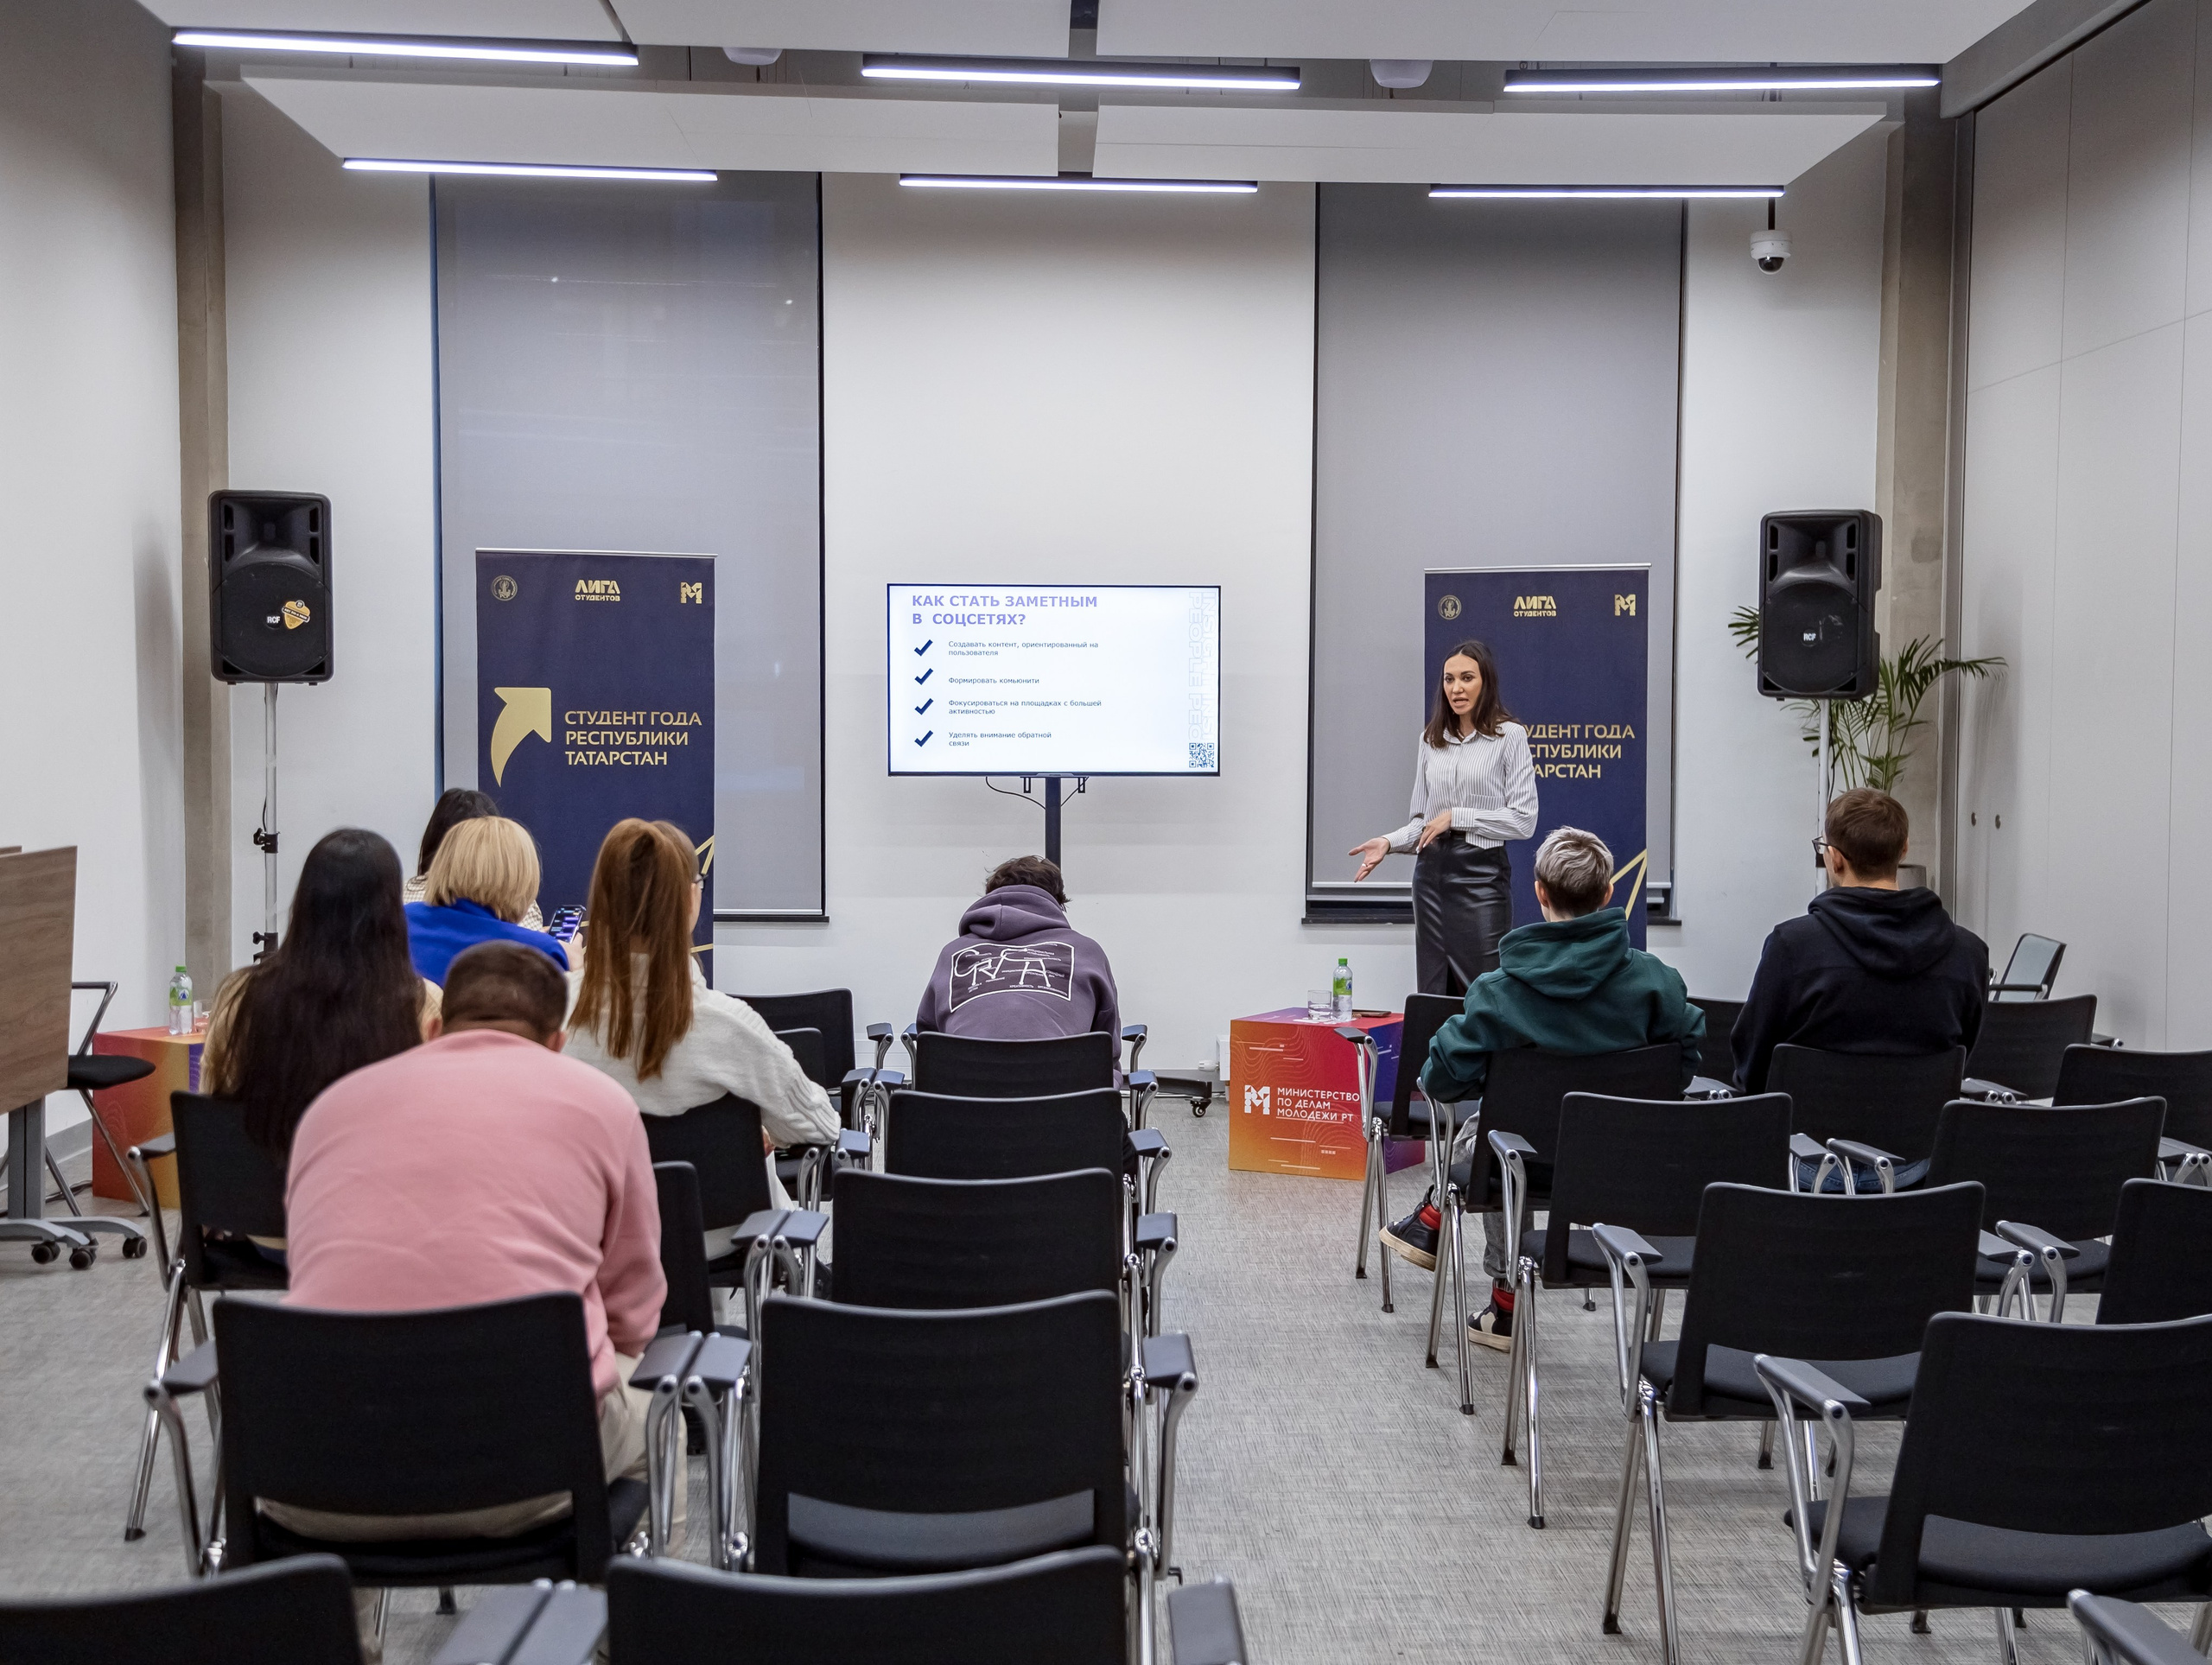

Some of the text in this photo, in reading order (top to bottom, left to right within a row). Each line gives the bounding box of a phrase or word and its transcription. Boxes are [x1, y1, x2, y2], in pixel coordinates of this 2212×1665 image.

[575, 579, 621, 594] ЛИГА
[575, 594, 621, 602] СТУДЕНТОВ
[912, 594, 1097, 607] КАК СТАТЬ ЗАМЕТНЫМ
[1513, 595, 1557, 610] ЛИГА
[266, 615, 281, 624] RCF
[912, 613, 1027, 627] В СОЦСЕТЯХ?
[1803, 632, 1817, 641] RCF
[948, 677, 998, 685] Формировать
[948, 699, 1008, 708] Фокусироваться
[564, 710, 702, 726] СТУДЕНТ ГОДА
[566, 730, 689, 746] РЕСПУБЛИКИ
[1017, 731, 1052, 740] обратной
[1524, 724, 1636, 739] УДЕНТ ГОДА
[564, 751, 667, 766] ТАТАРСТАН
[1529, 744, 1622, 759] СПУБЛИКИ
[1533, 764, 1601, 778] АРСТАН
[1276, 1087, 1360, 1102] МИНИСТЕРСТВО
[1277, 1097, 1331, 1110] ПО ДЕЛАМ
[1276, 1108, 1354, 1122] МОЛОДЕЖИ РТ
